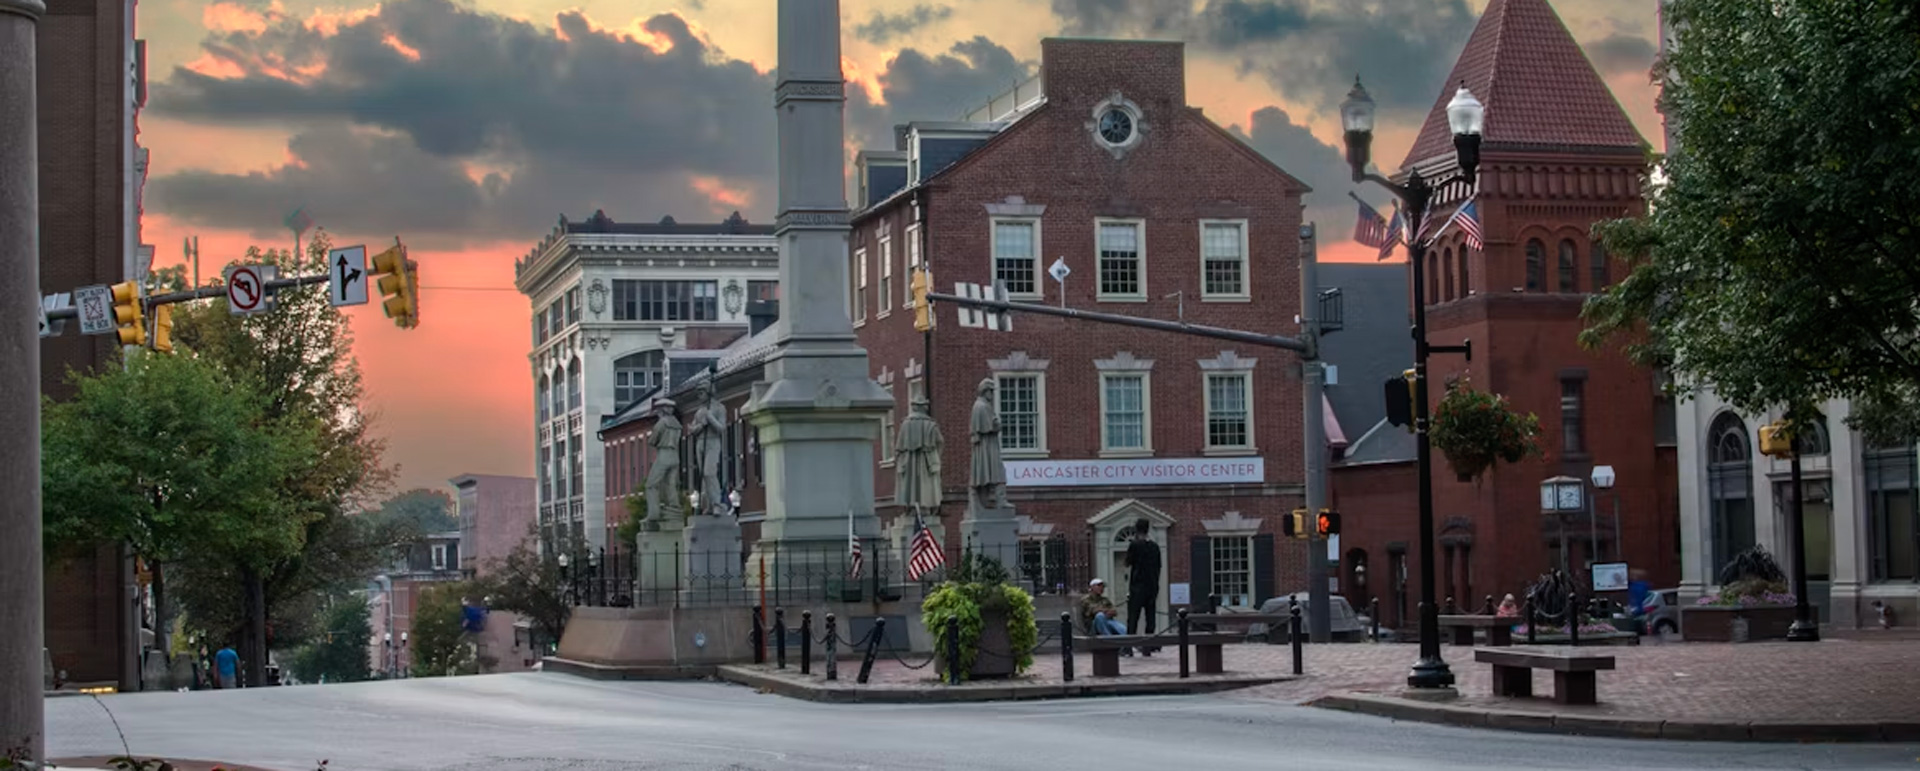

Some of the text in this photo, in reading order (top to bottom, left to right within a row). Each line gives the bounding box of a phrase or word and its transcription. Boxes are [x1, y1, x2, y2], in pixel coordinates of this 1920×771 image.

[83, 319, 109, 330] THE BOX
[1013, 463, 1256, 479] LANCASTER CITY VISITOR CENTER
